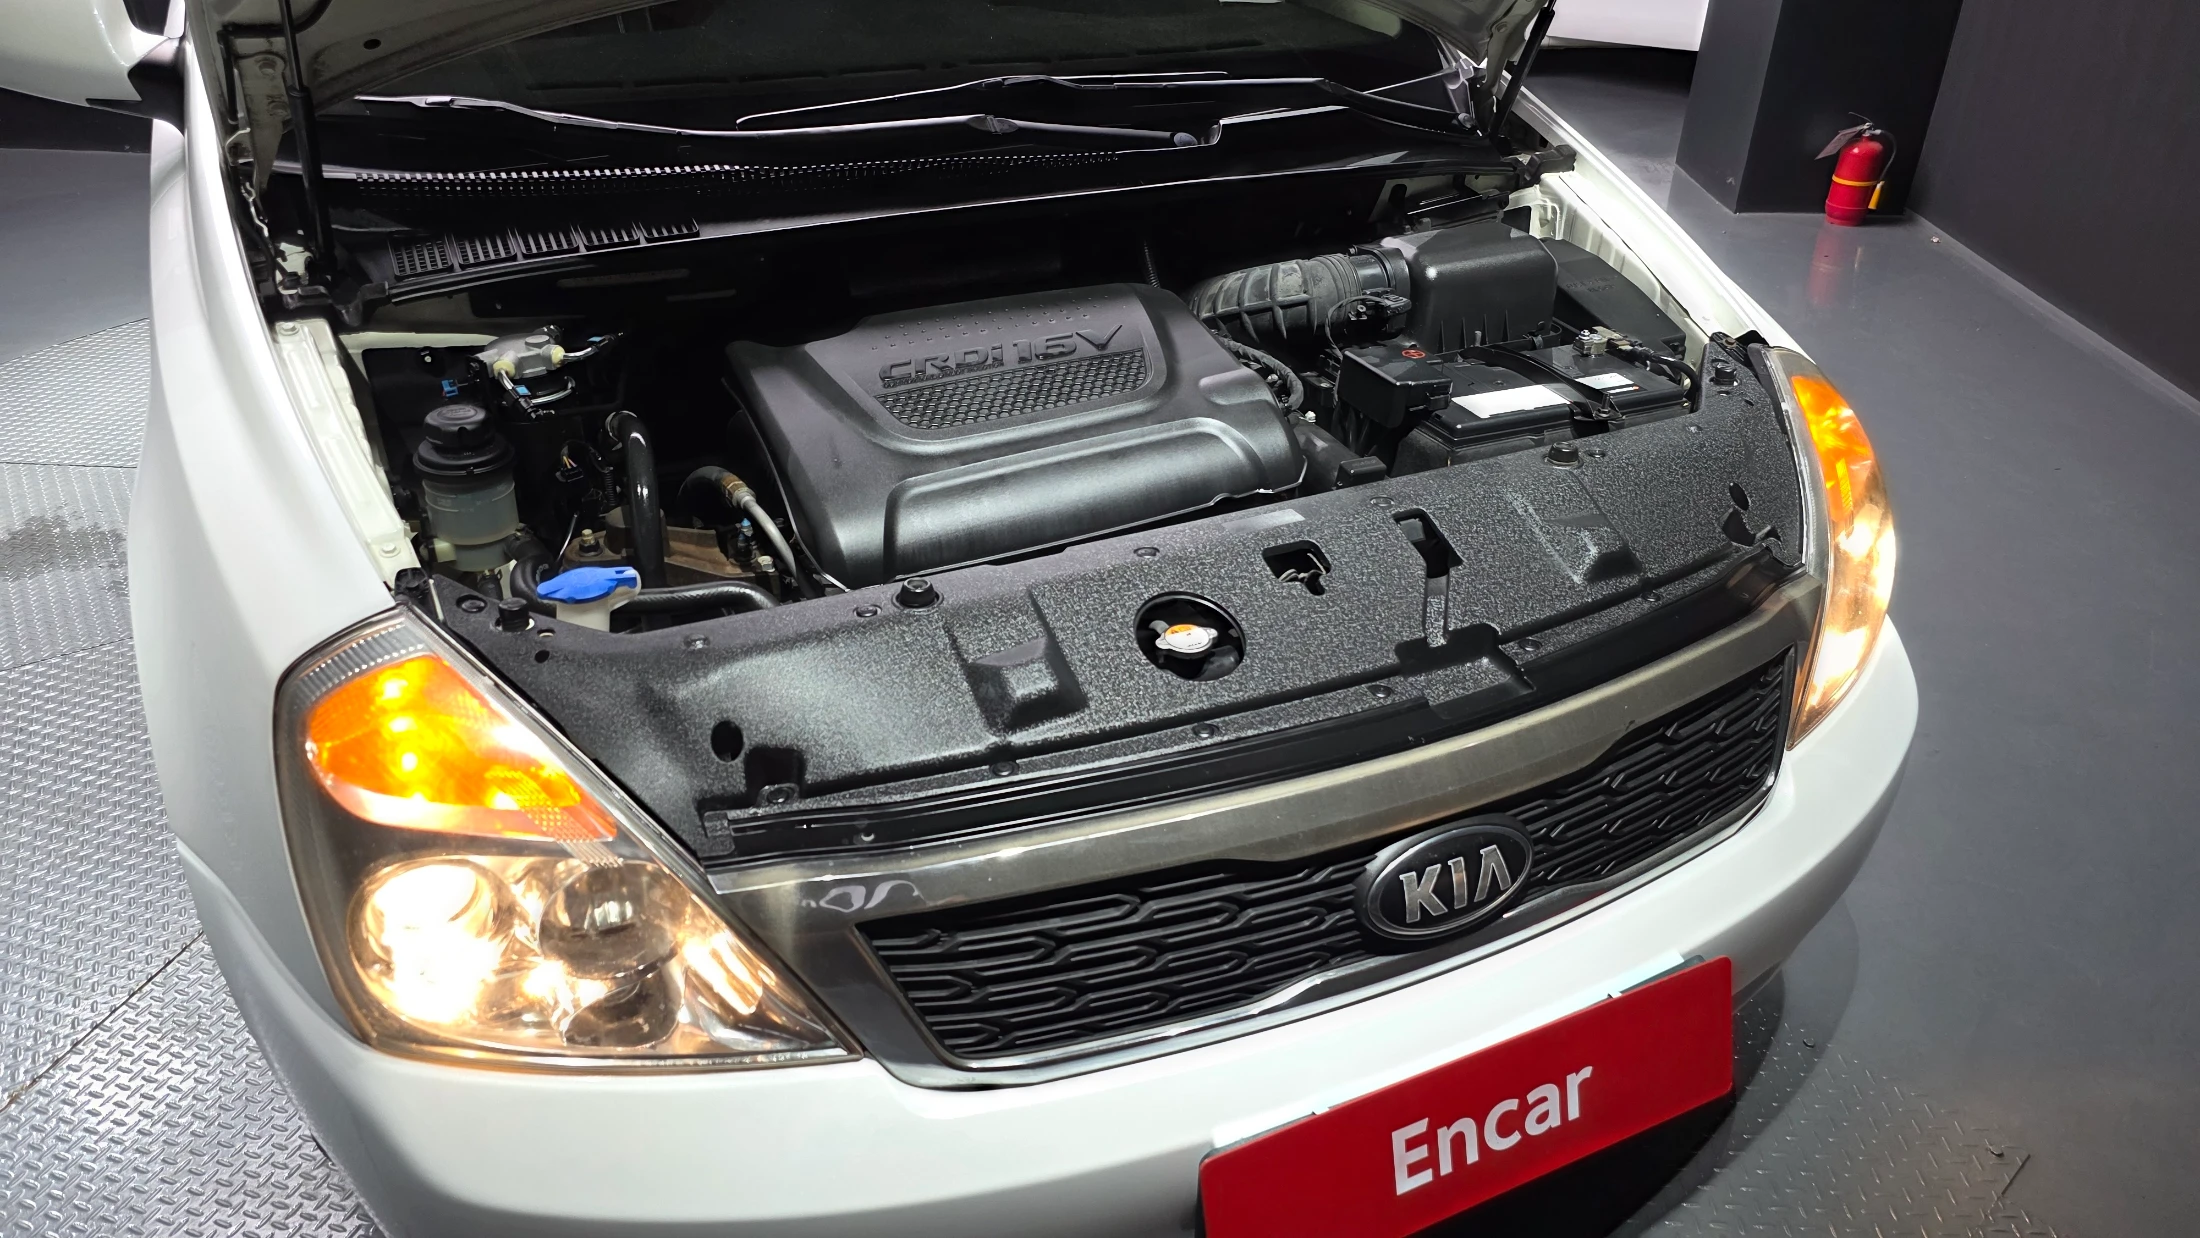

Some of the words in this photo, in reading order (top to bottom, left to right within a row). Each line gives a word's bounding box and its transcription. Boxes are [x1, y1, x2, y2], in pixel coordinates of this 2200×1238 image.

[878, 343, 1004, 384] CRDi
[1399, 844, 1512, 923] KIA
[1391, 1065, 1593, 1196] Encar
